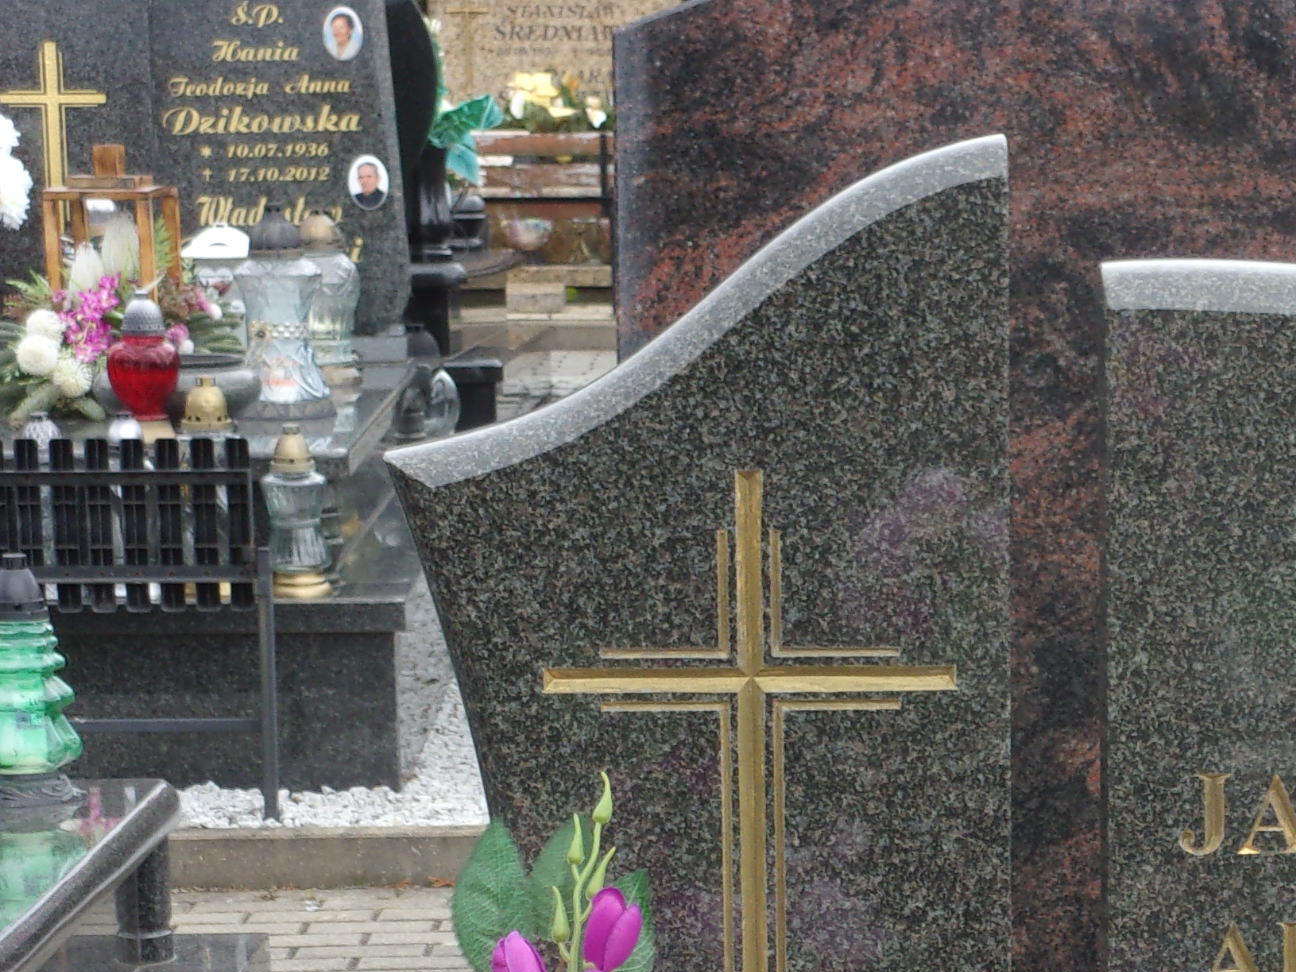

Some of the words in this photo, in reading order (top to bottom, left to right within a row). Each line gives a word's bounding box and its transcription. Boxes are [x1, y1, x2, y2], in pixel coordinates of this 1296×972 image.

[212, 40, 300, 62] Hania
[169, 76, 270, 99] Teodozja
[284, 75, 351, 94] Anna
[162, 104, 362, 135] Dzikowska
[226, 142, 330, 158] 10.07.1936
[227, 166, 330, 182] 17.10.2012
